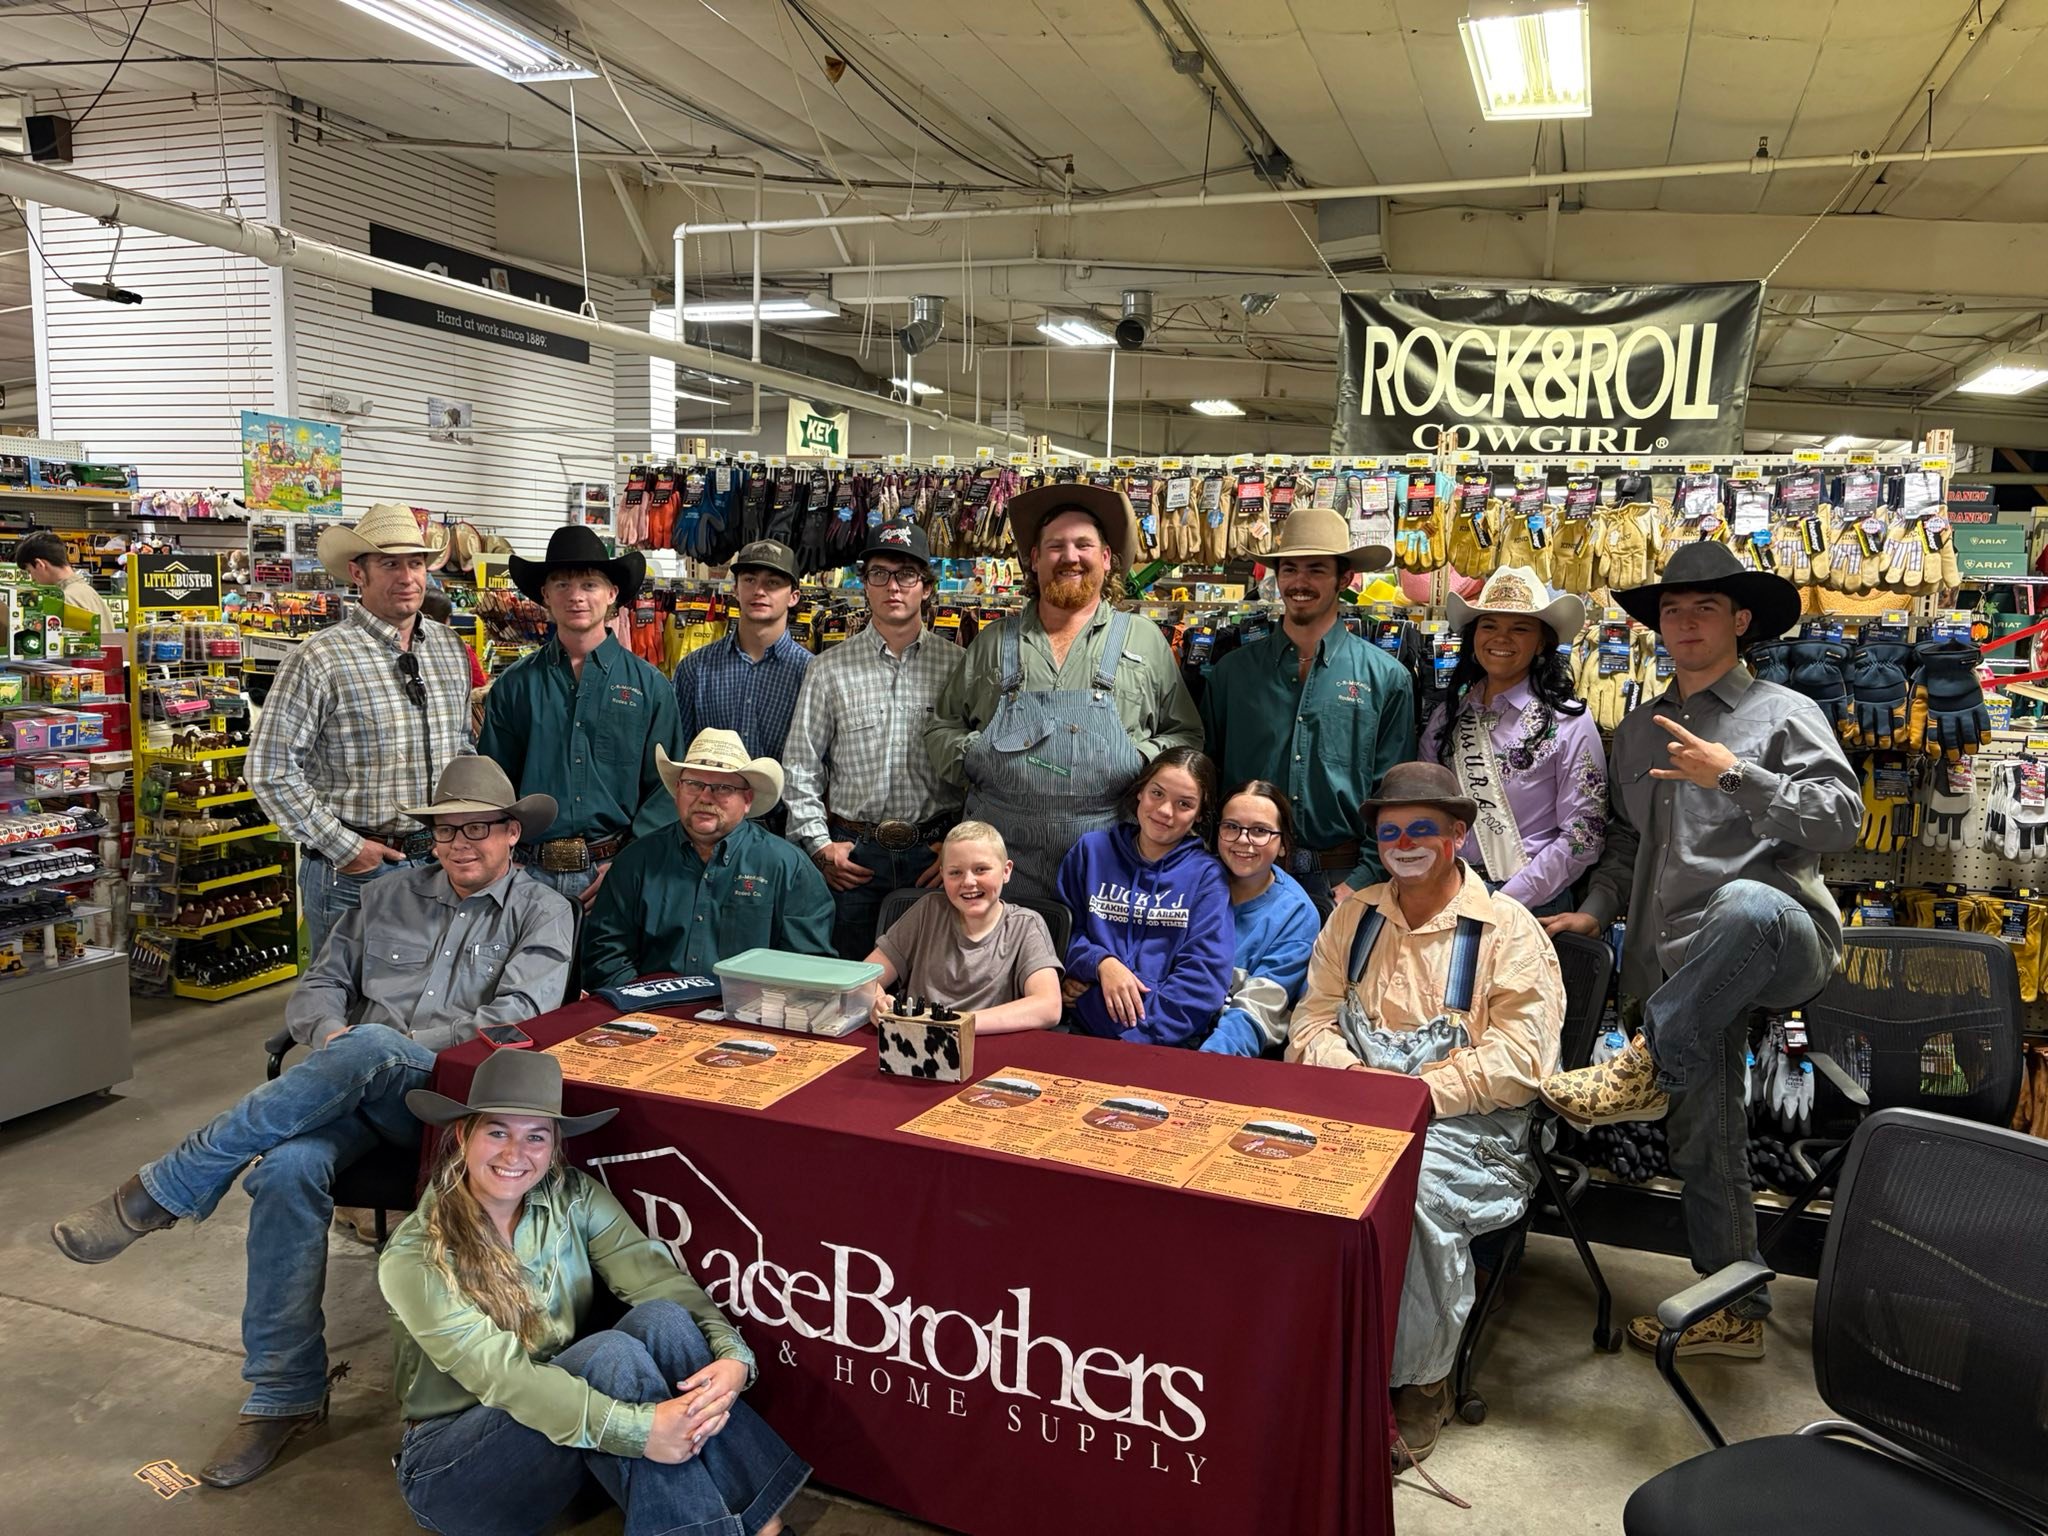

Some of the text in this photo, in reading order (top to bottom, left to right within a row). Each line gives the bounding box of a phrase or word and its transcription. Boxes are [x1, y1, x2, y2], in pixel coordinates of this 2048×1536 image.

[437, 310, 462, 327] Hard
[464, 319, 474, 330] at
[476, 322, 499, 336] work
[501, 328, 524, 342] since
[1360, 323, 1719, 420] ROCK&ROLL
[807, 418, 834, 443] KEY
[1975, 561, 2014, 569] ARIAT
[1460, 712, 1487, 751] Miss
[1481, 812, 1507, 836] 2025
[1091, 896, 1145, 918] STEAKHOS
[1156, 910, 1187, 919] ARENA
[1098, 883, 1185, 909] LUCKY J
[1108, 914, 1129, 923] FOOD
[1080, 1132, 1106, 1141] Thank
[1152, 1147, 1188, 1158] Sponsors
[1233, 1161, 1260, 1170] Thank
[1312, 1176, 1354, 1187] Sponsors
[778, 1340, 1208, 1486] & HOME SUPPLY
